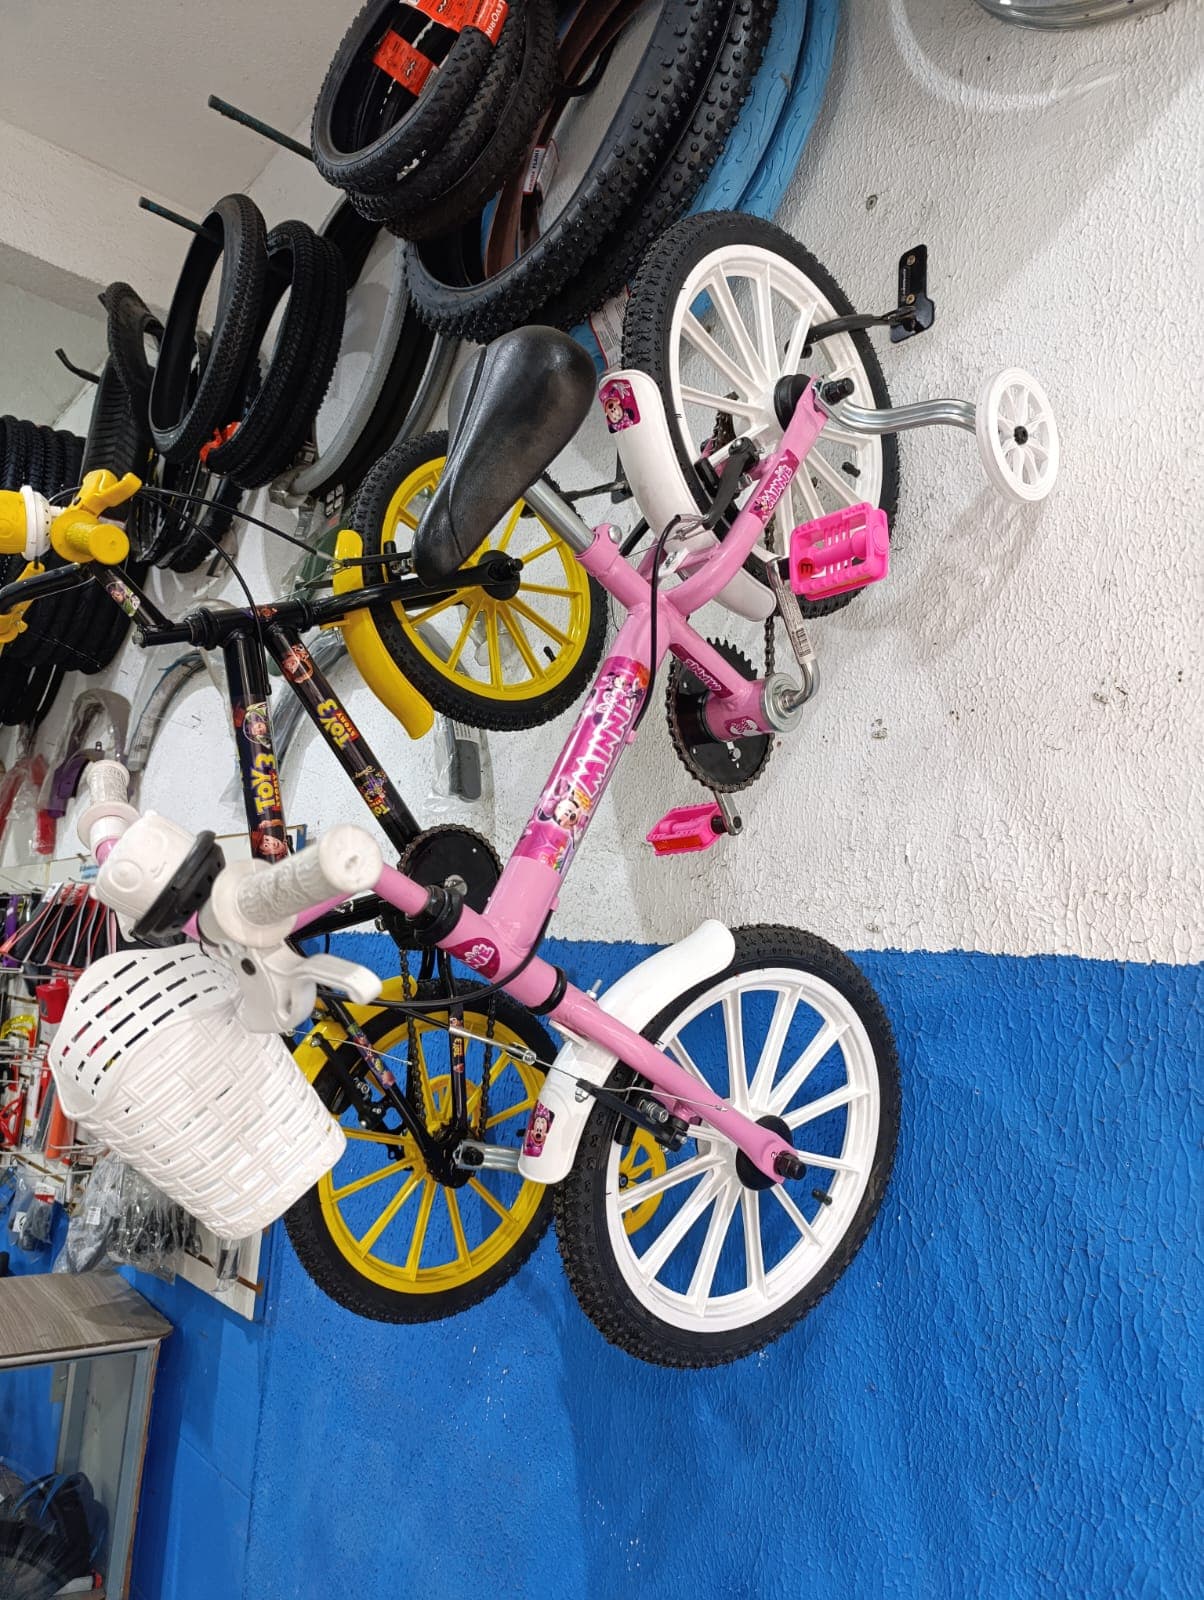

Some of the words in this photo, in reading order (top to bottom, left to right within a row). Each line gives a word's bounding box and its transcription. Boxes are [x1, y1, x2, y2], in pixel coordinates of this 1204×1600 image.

[317, 698, 338, 717] 3
[319, 717, 351, 748] TOY
[255, 753, 276, 770] 3
[252, 769, 274, 815] TOY
